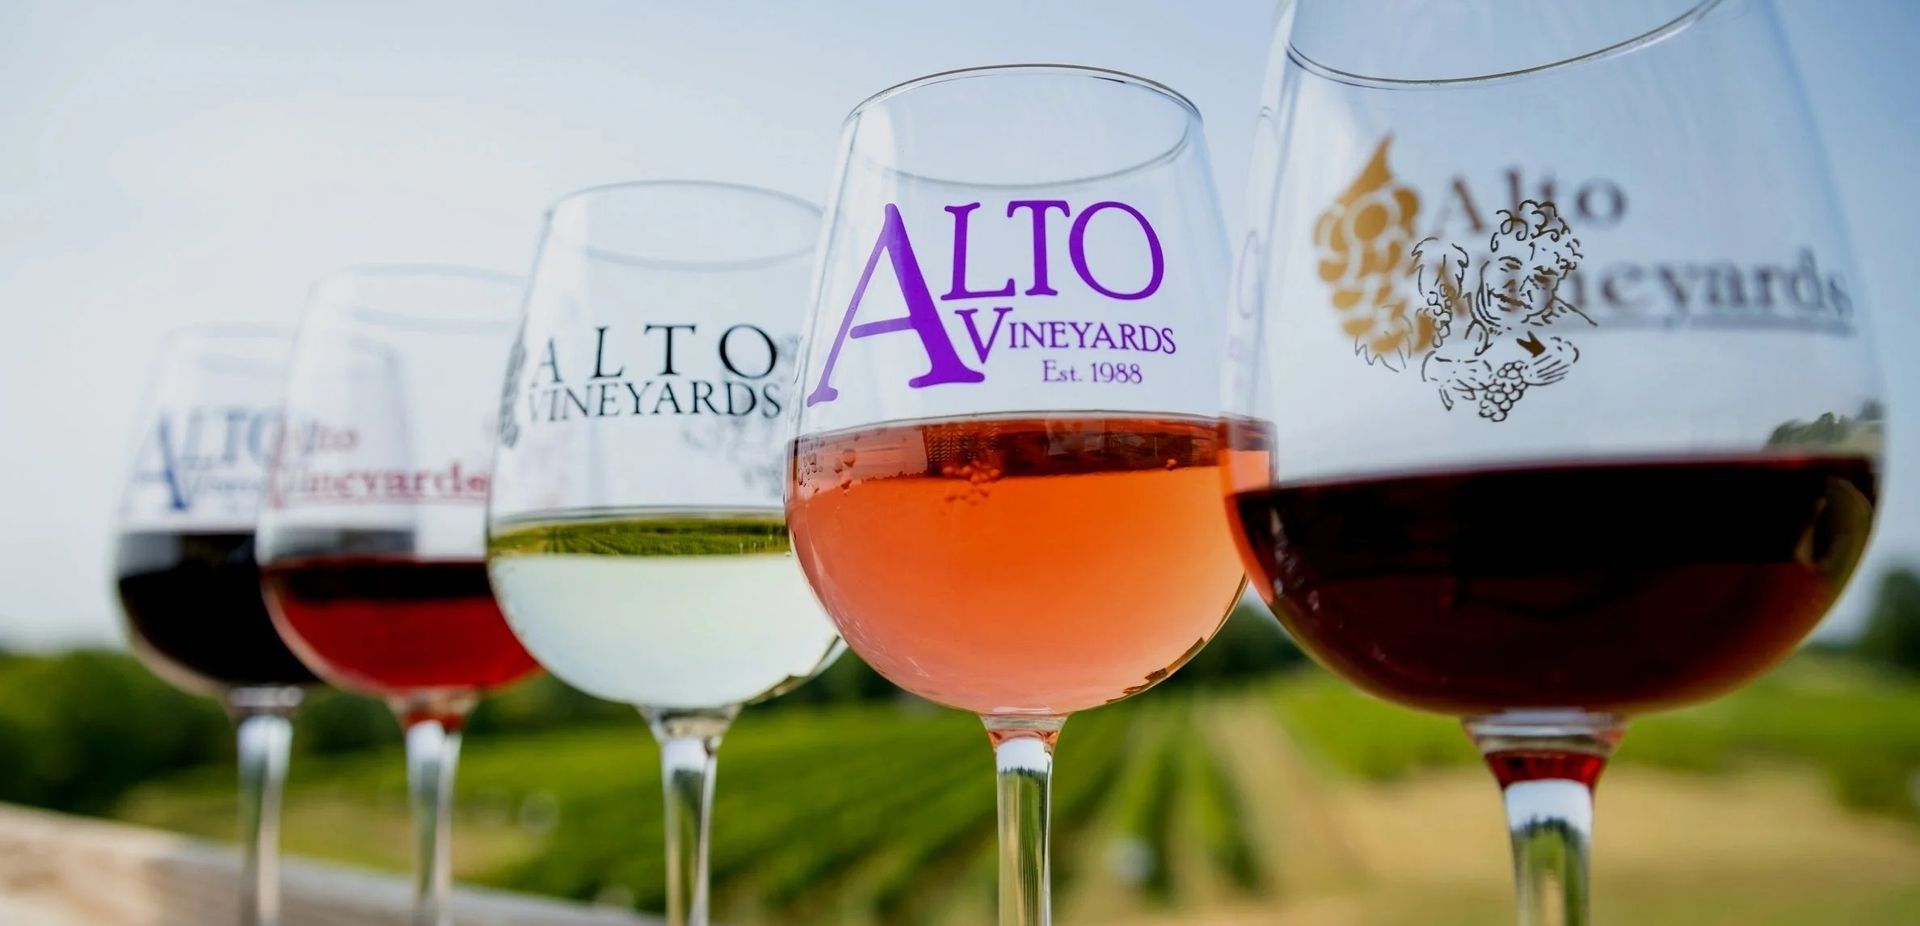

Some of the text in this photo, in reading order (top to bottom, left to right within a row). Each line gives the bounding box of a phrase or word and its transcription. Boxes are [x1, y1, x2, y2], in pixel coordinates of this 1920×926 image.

[1430, 167, 1629, 236] Alto
[807, 199, 1165, 407] ALTO
[529, 324, 778, 382] ALTO
[954, 307, 1177, 365] VINEYARDS
[528, 379, 783, 423] VINEYARDS
[1042, 359, 1143, 385] Est. 1988
